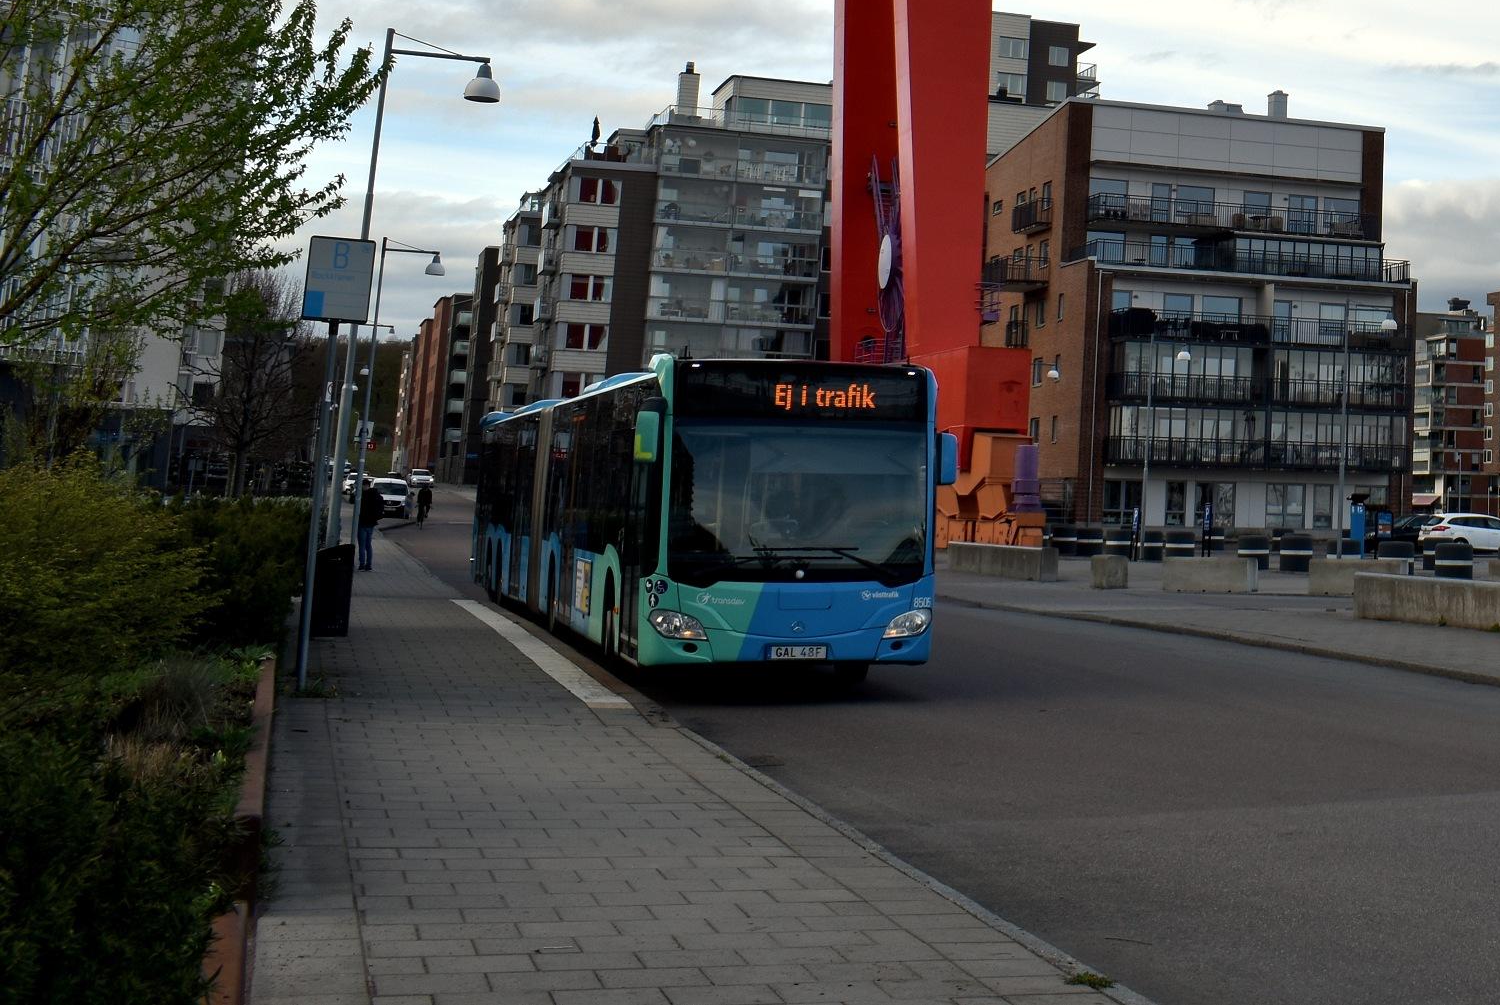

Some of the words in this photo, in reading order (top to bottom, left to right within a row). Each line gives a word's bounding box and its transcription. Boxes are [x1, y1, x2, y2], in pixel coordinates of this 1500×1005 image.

[333, 242, 350, 269] B
[775, 384, 792, 410] Ej
[802, 385, 807, 406] i
[816, 384, 876, 408] trafik
[775, 647, 796, 658] GAL
